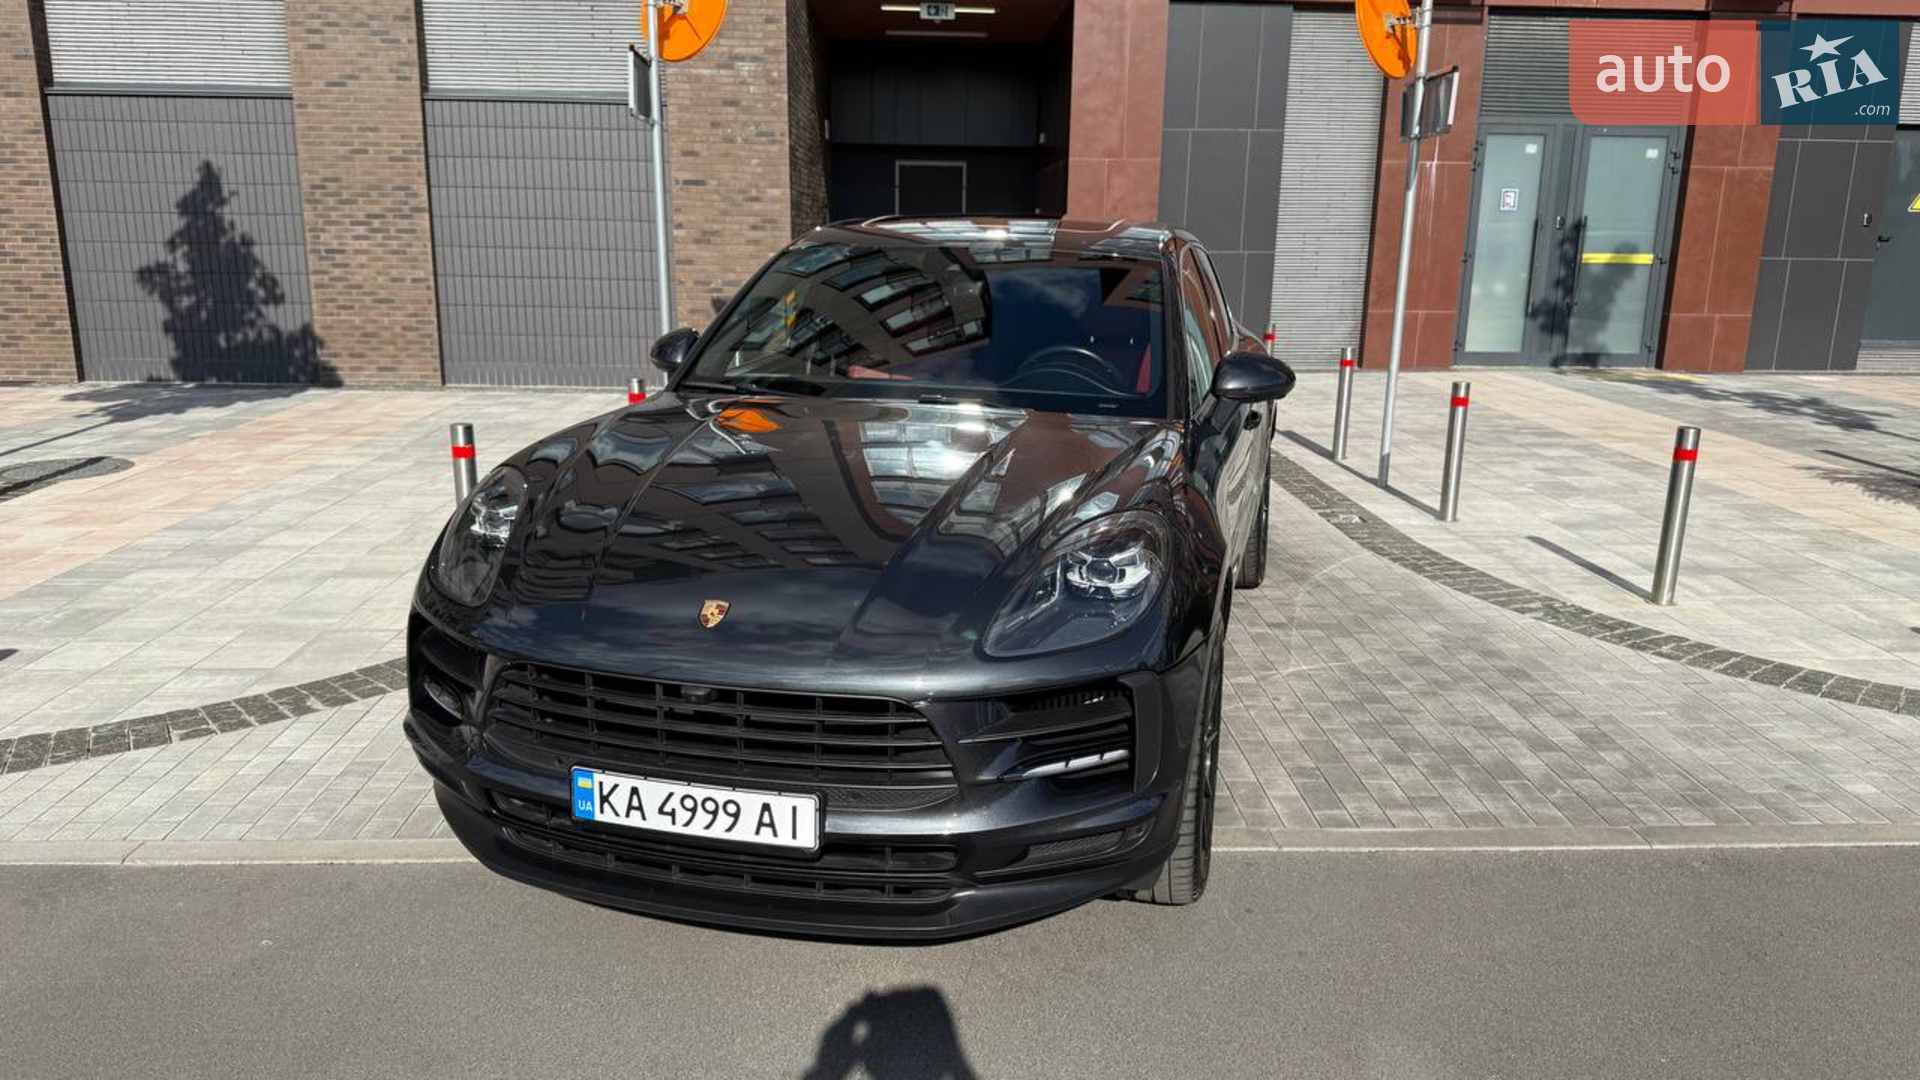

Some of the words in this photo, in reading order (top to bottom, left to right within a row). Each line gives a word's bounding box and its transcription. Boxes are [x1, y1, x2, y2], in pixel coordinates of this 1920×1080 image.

[578, 799, 593, 812] UA
[598, 781, 647, 821] KA
[657, 792, 742, 833] 4999
[754, 802, 798, 840] AI
